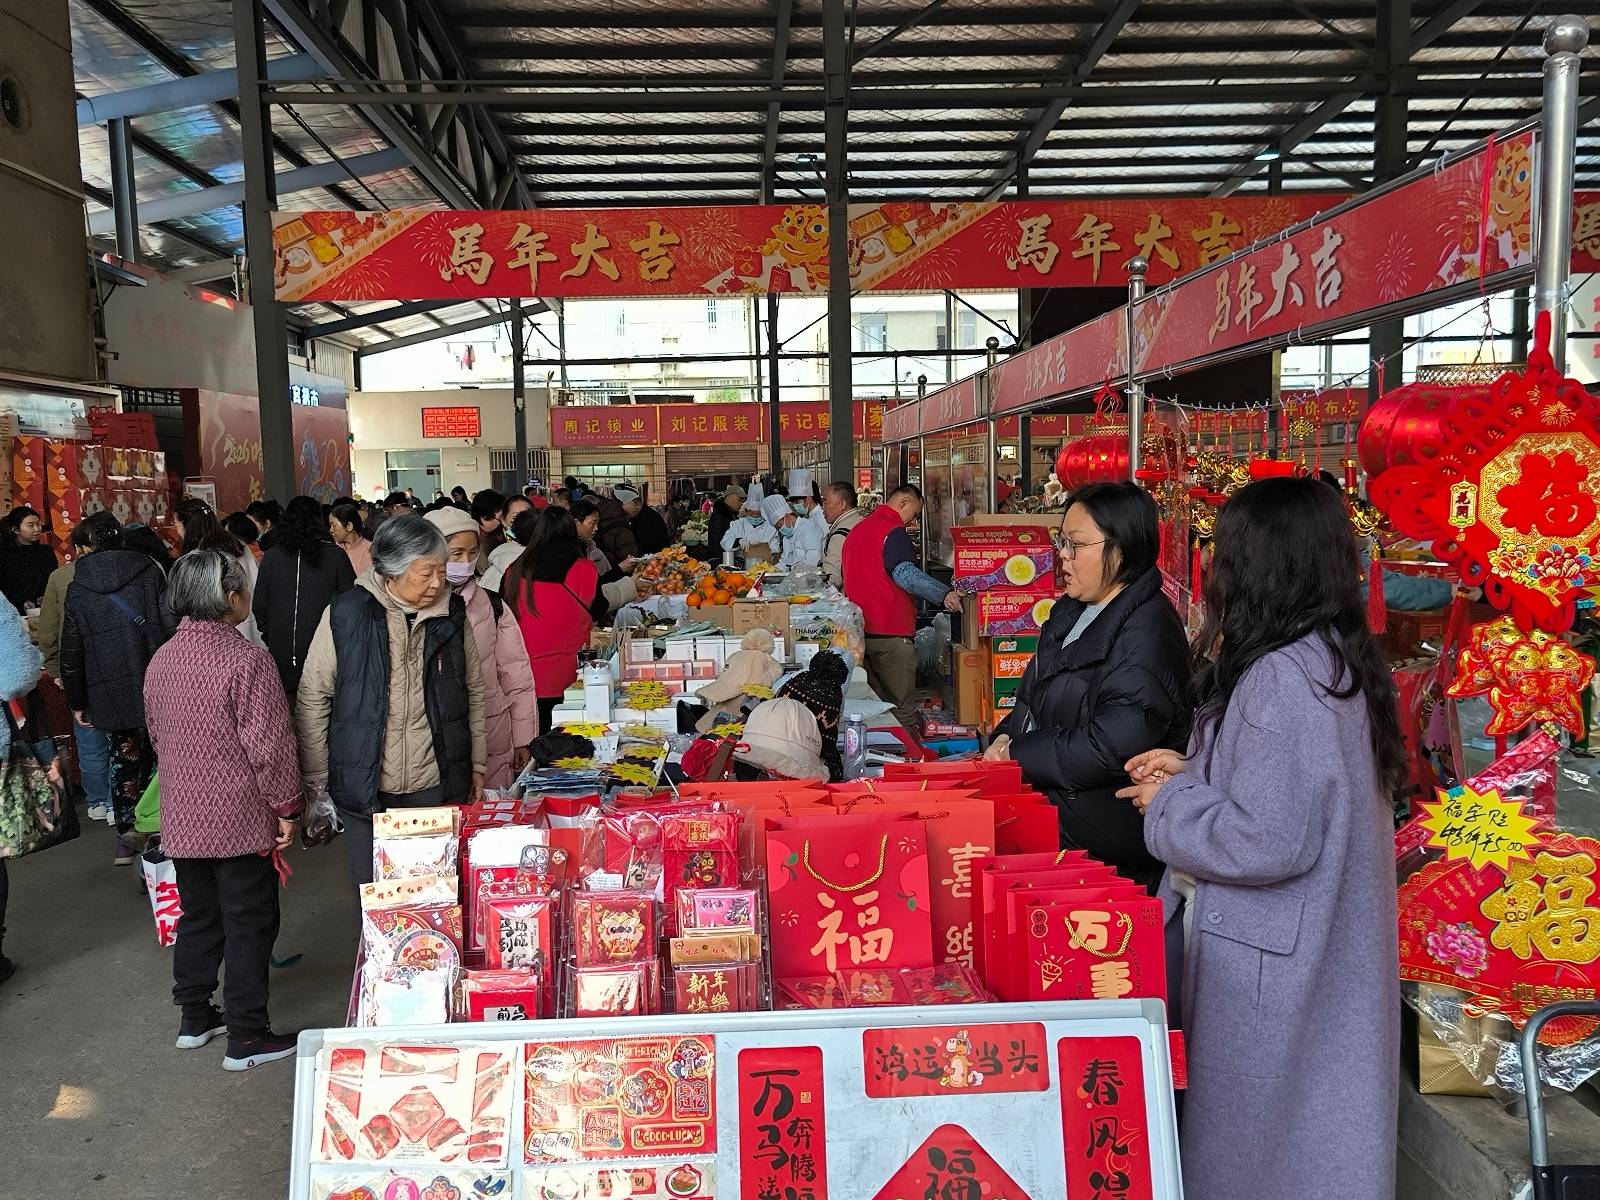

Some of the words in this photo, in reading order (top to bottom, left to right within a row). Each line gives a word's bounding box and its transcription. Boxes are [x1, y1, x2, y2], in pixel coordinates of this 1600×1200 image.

[440, 222, 681, 296] 馬年大吉
[1006, 211, 1243, 284] 馬年大吉
[564, 418, 645, 434] 周记锁业
[671, 415, 749, 432] 刘记服装
[810, 890, 894, 973] 福
[1480, 851, 1600, 964] 福
[686, 970, 729, 999] 新年
[875, 1039, 1040, 1082] 鸿运当头
